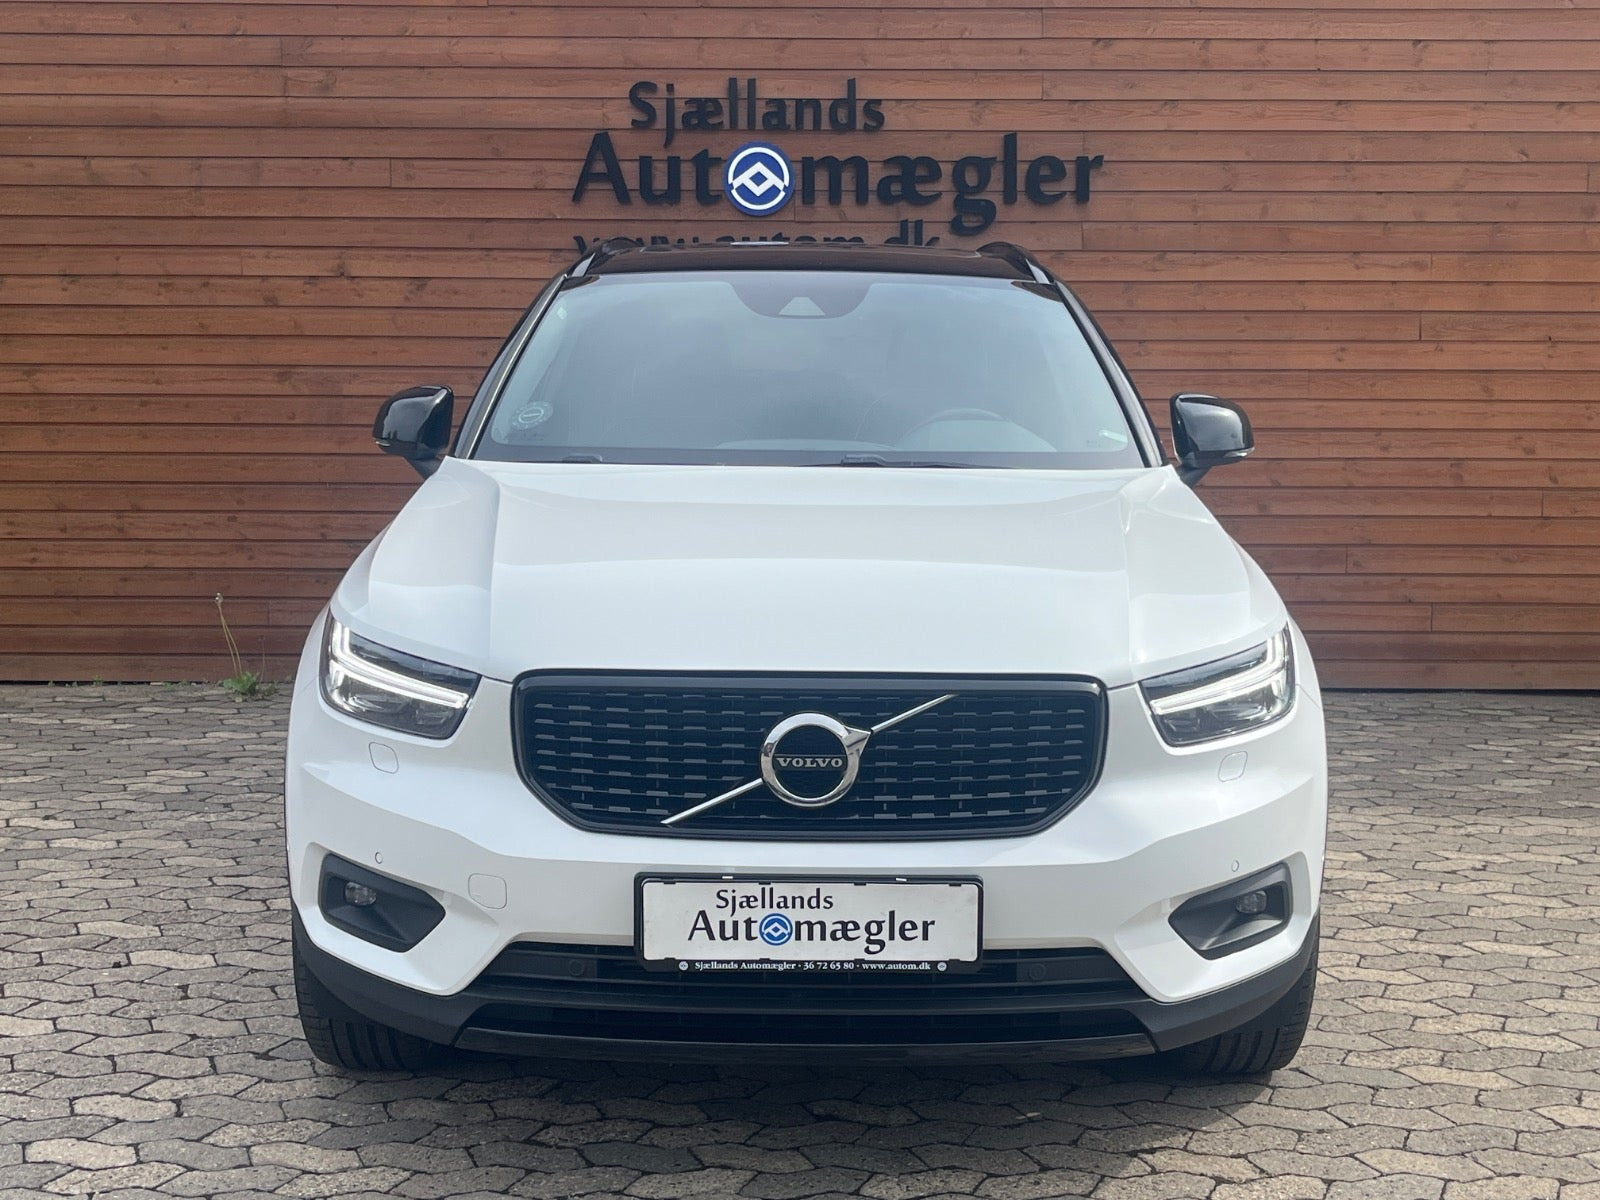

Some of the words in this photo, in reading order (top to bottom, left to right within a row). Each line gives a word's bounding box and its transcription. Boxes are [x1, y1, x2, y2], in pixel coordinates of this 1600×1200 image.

[628, 77, 886, 148] Sjællands
[776, 758, 843, 767] VOLVO
[715, 886, 834, 917] Sjællands
[694, 961, 739, 971] Sjællands
[740, 961, 797, 971] Automægler
[803, 961, 815, 971] 36
[817, 961, 828, 970] 72
[829, 961, 841, 971] 65
[843, 961, 855, 970] 80
[861, 961, 931, 970] www.autom.dk
